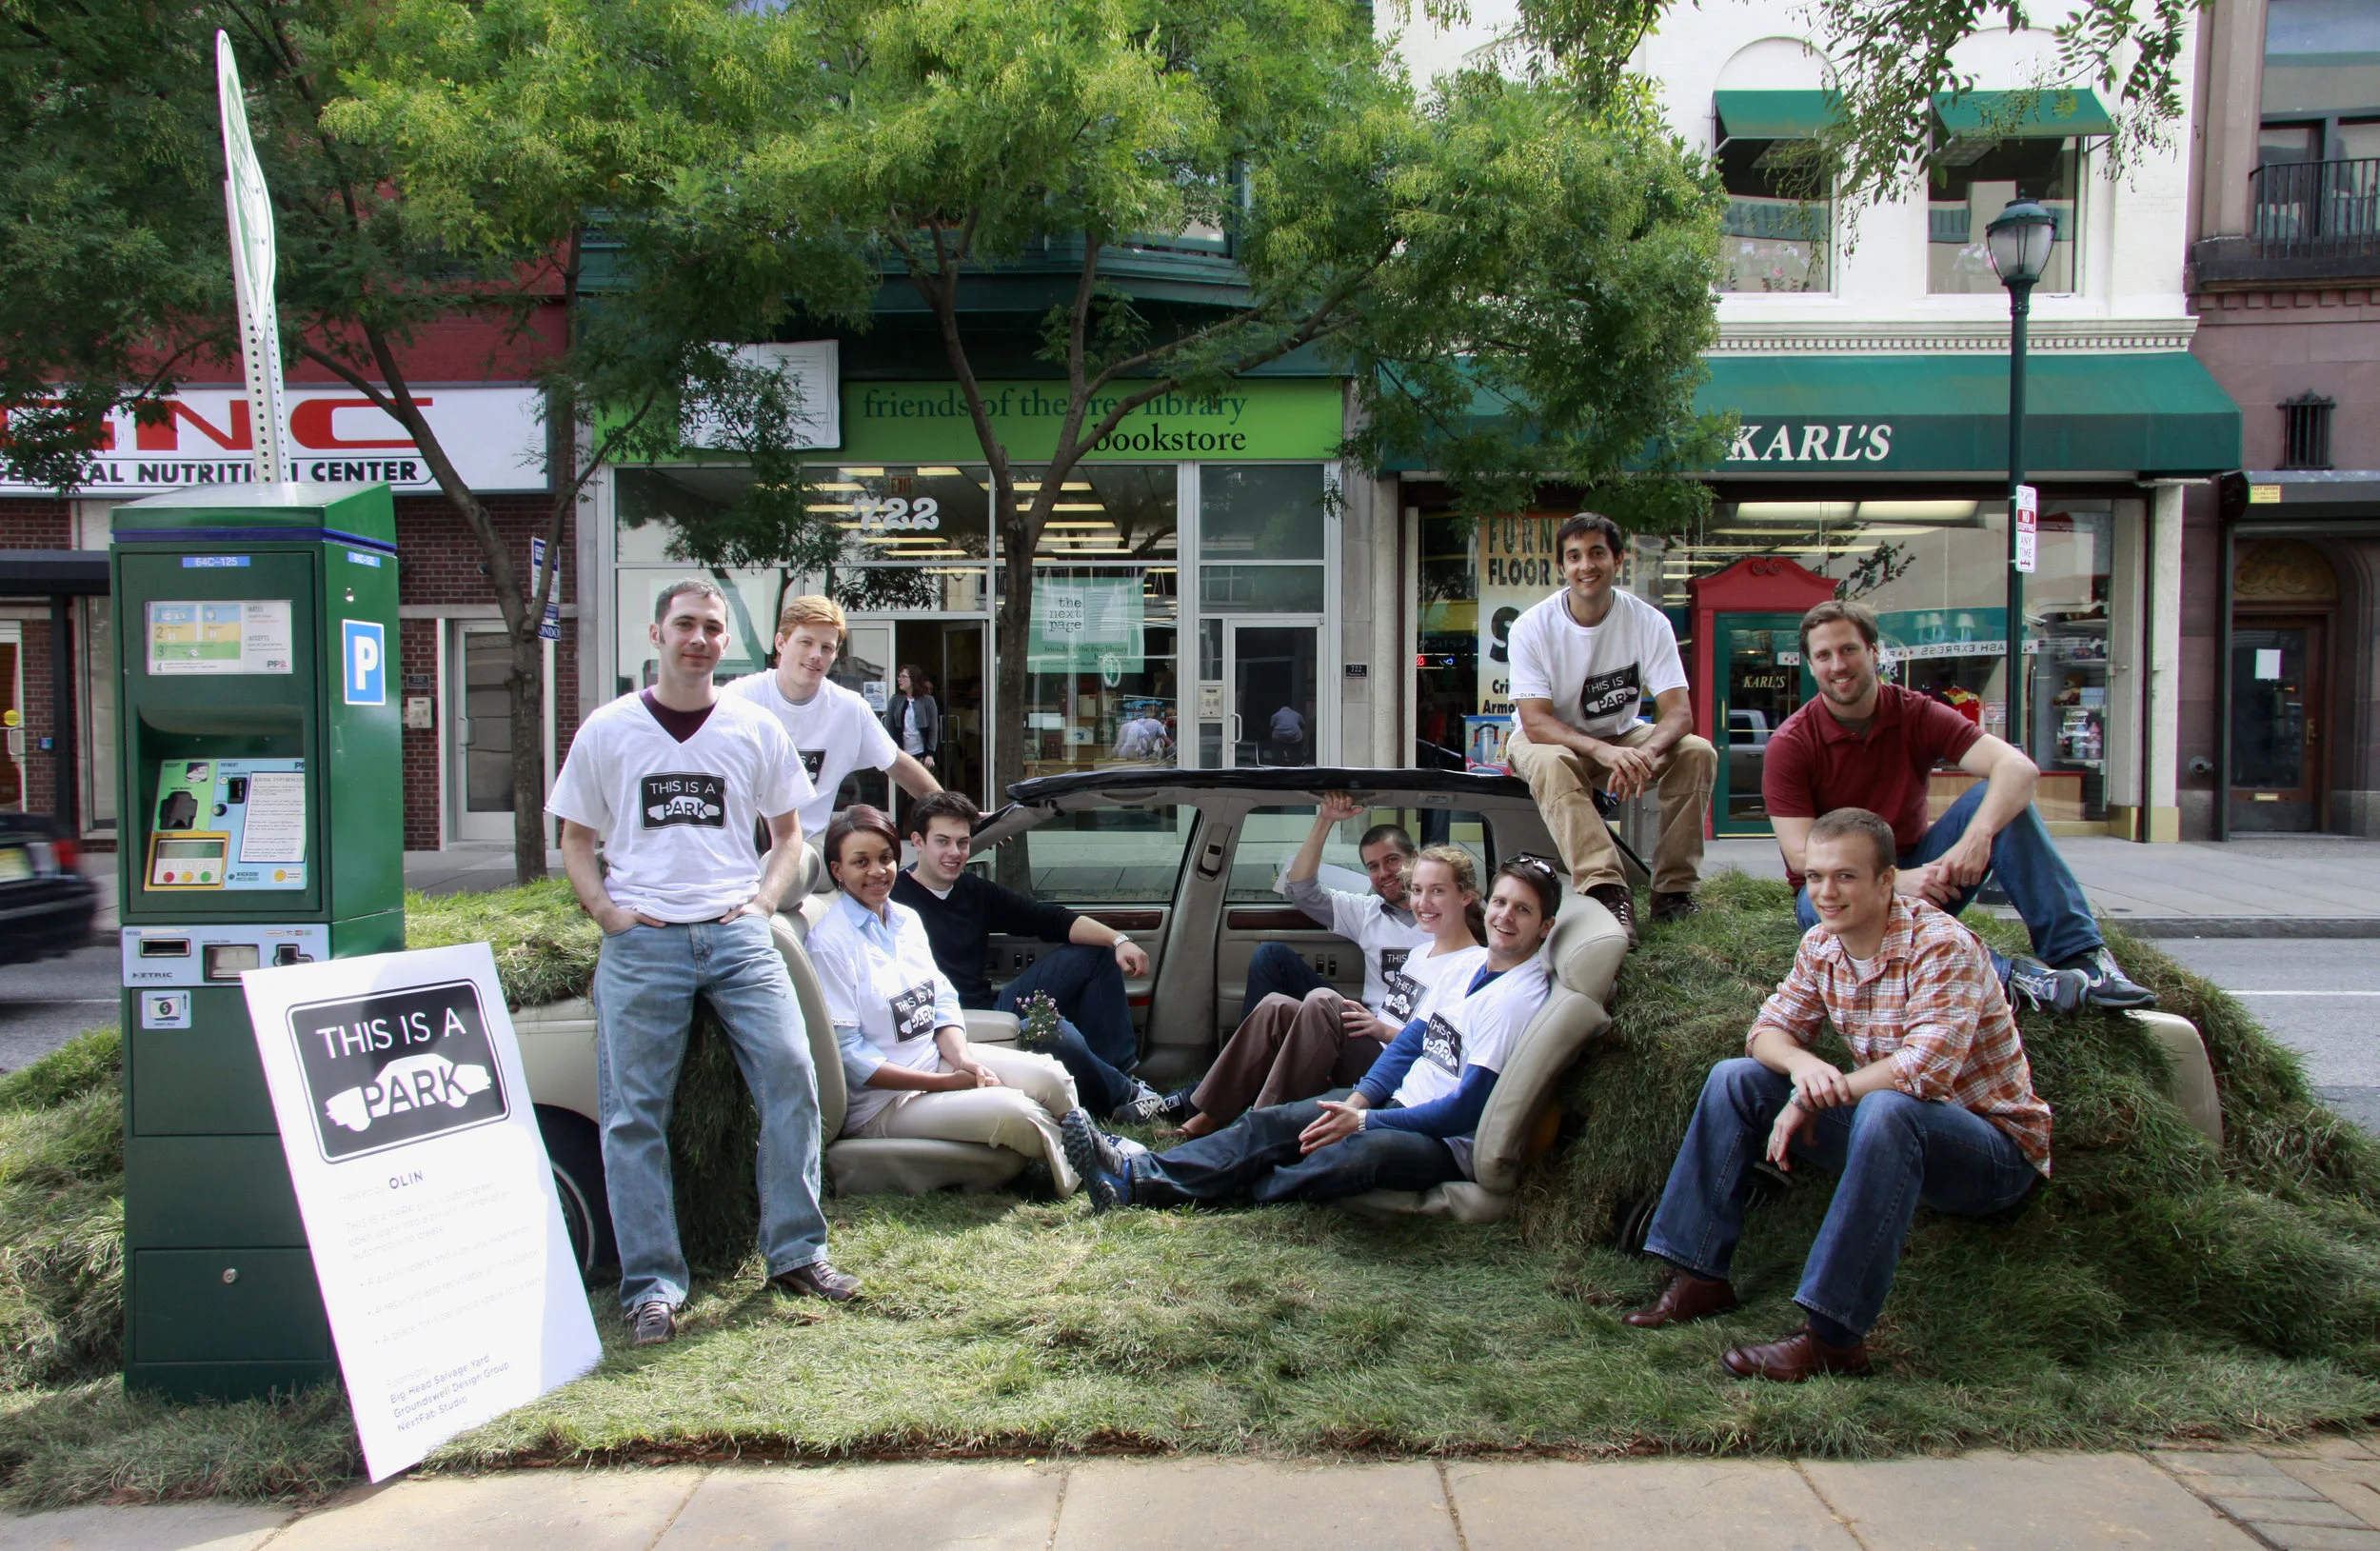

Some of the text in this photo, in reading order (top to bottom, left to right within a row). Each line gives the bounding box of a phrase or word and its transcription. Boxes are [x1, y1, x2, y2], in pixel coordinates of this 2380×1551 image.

[863, 388, 968, 417] friends
[982, 388, 1016, 416] of
[1020, 388, 1068, 417] the
[1092, 423, 1247, 451] bookstore
[1725, 424, 1893, 462] KARL'S
[137, 462, 299, 485] NUTRITI
[311, 461, 418, 482] CENTER
[890, 477, 912, 494] EXIT
[853, 497, 940, 530] 722
[2020, 535, 2033, 547] ANY
[2019, 547, 2033, 559] TIME
[1488, 557, 1551, 587] FLOOR
[1057, 596, 1082, 608] the
[1048, 608, 1082, 619] next
[1048, 620, 1082, 633] page
[353, 635, 379, 689] P
[1492, 678, 1510, 694] Cri
[1584, 680, 1610, 694] THIS
[1612, 676, 1624, 687] IS
[1743, 675, 1786, 688] KARL'S
[1482, 699, 1516, 714] Armo
[648, 780, 716, 795] THIS IS A
[663, 801, 708, 818] PARK
[1386, 953, 1408, 964] THIS
[896, 987, 935, 1013] THIS IS A
[315, 1006, 467, 1060] THIS IS A
[1429, 1019, 1446, 1037] THIS
[360, 1064, 468, 1120] PARK
[388, 1169, 424, 1189] OLIN
[389, 1352, 490, 1404] Big Head Salvage Yard
[393, 1362, 509, 1419] Groundswell Design Group
[397, 1395, 467, 1432] NextFab Studio
